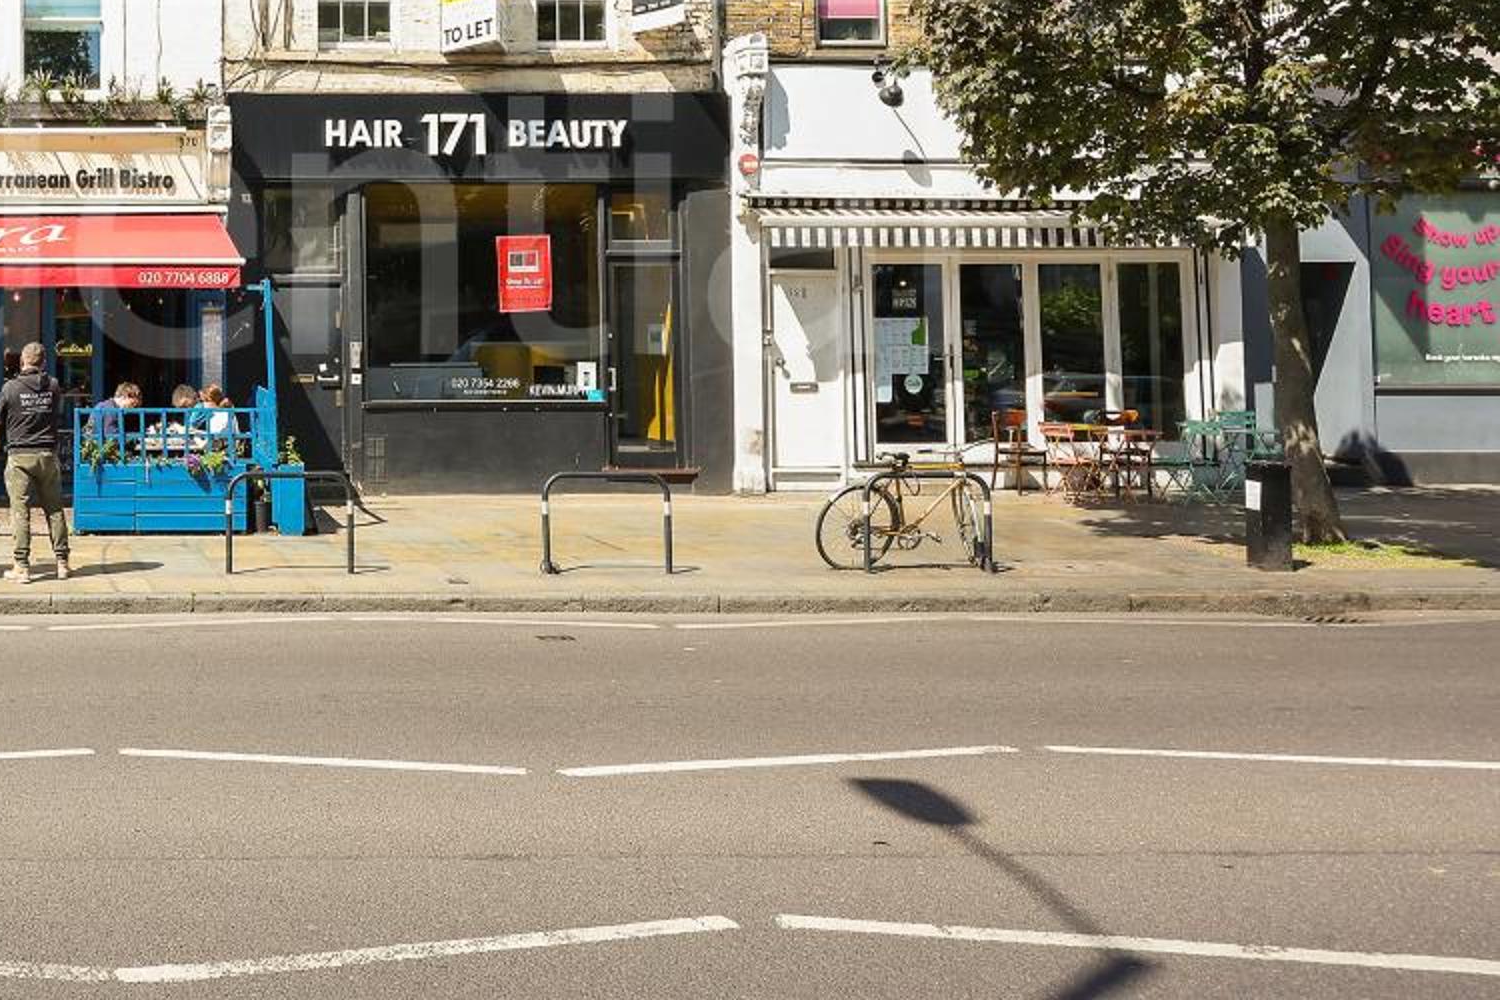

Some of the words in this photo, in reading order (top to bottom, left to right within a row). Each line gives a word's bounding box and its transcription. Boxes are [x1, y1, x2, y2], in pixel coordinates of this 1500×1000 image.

[444, 27, 463, 45] TO
[467, 18, 492, 40] LET
[325, 119, 403, 148] HAIR
[421, 113, 487, 156] 171
[508, 119, 627, 149] BEAUTY
[75, 168, 114, 188] Grill
[119, 169, 174, 189] Bistro
[138, 271, 161, 284] 020
[164, 271, 196, 284] 7704
[198, 271, 229, 285] 6888
[1441, 260, 1500, 291] your
[1406, 288, 1498, 327] heart
